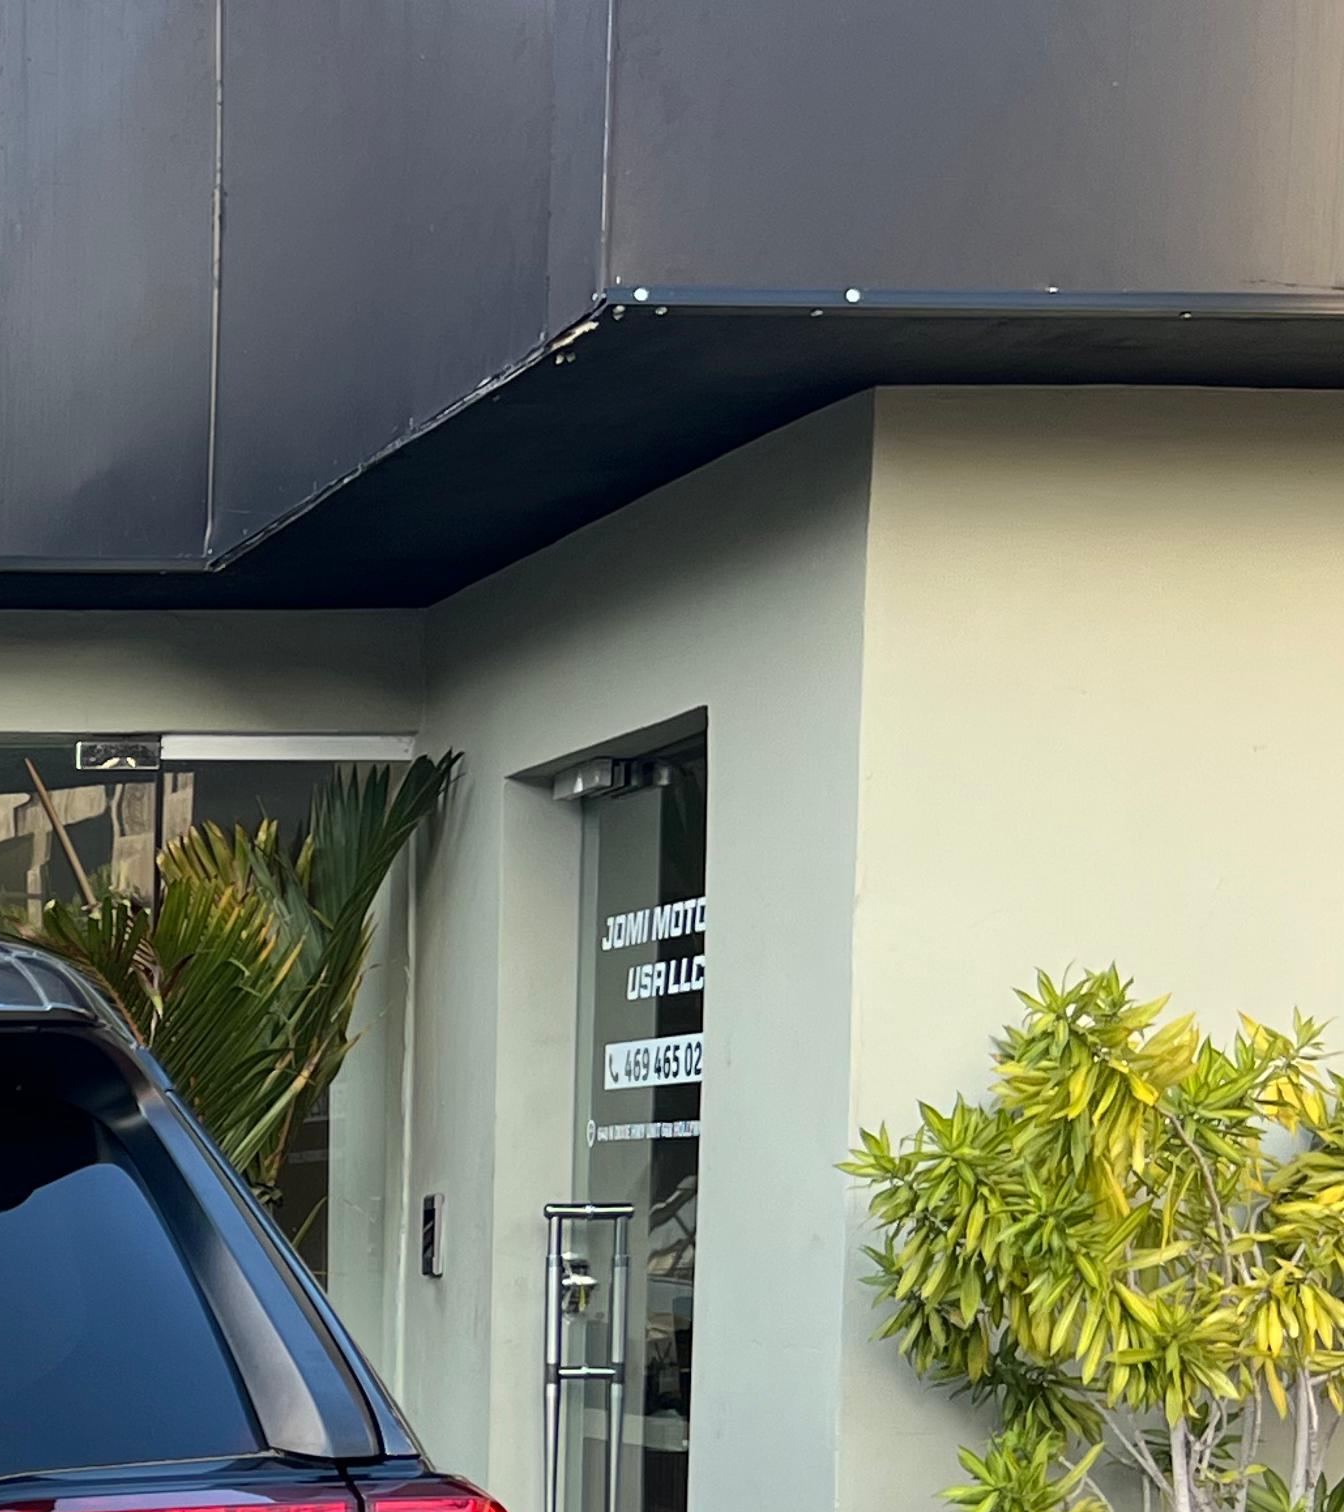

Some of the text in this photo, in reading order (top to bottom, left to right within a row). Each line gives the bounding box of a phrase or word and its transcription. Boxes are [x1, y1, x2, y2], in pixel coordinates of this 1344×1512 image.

[601, 897, 707, 952] JOMI MOTO
[625, 954, 705, 1001] USA LLC
[624, 1040, 703, 1083] 469 465 02
